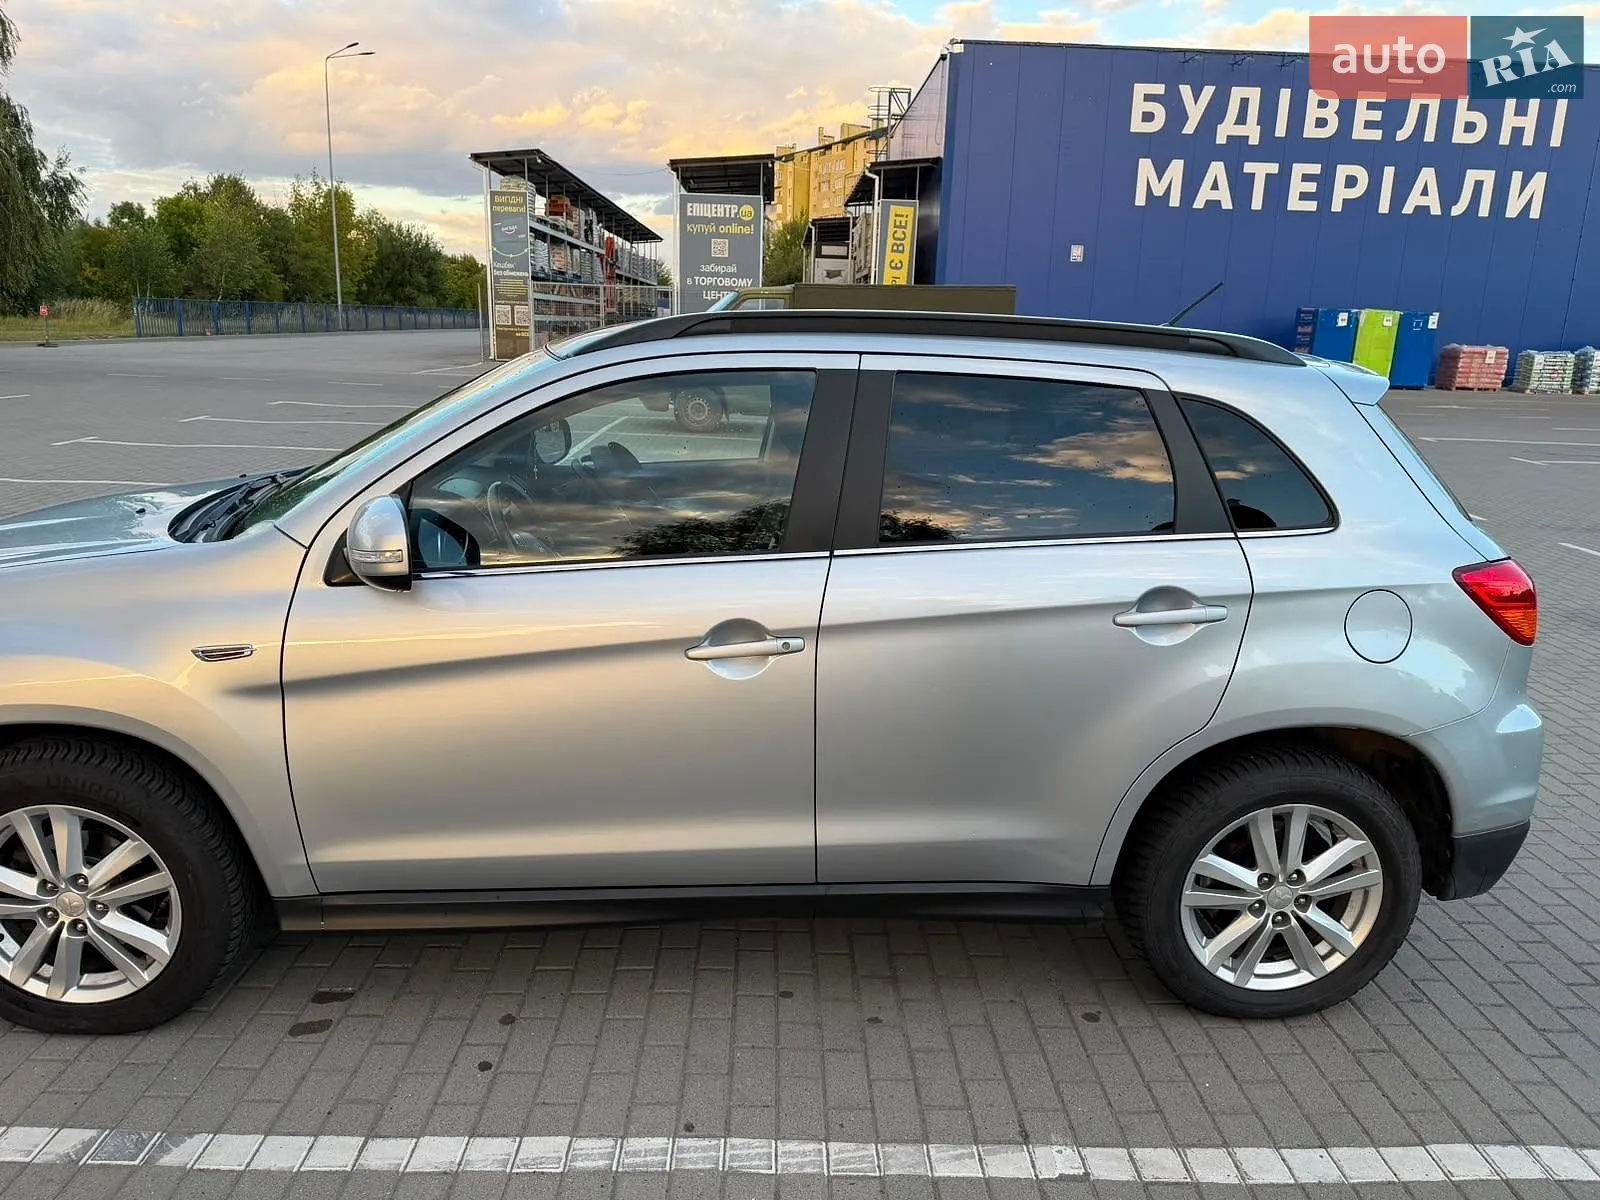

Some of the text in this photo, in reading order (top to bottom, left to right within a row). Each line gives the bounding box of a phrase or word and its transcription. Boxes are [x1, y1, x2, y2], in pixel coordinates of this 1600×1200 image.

[1130, 83, 1569, 147] БУДІВЕЛЬНІ
[1134, 158, 1547, 219] МАТЕРІАЛИ
[686, 223, 754, 235] купуй online!
[891, 213, 909, 253] ВСЕ!
[700, 264, 737, 274] забирай
[694, 277, 753, 287] ТОРГОВОМУ
[703, 291, 729, 301] ЦЕНТ
